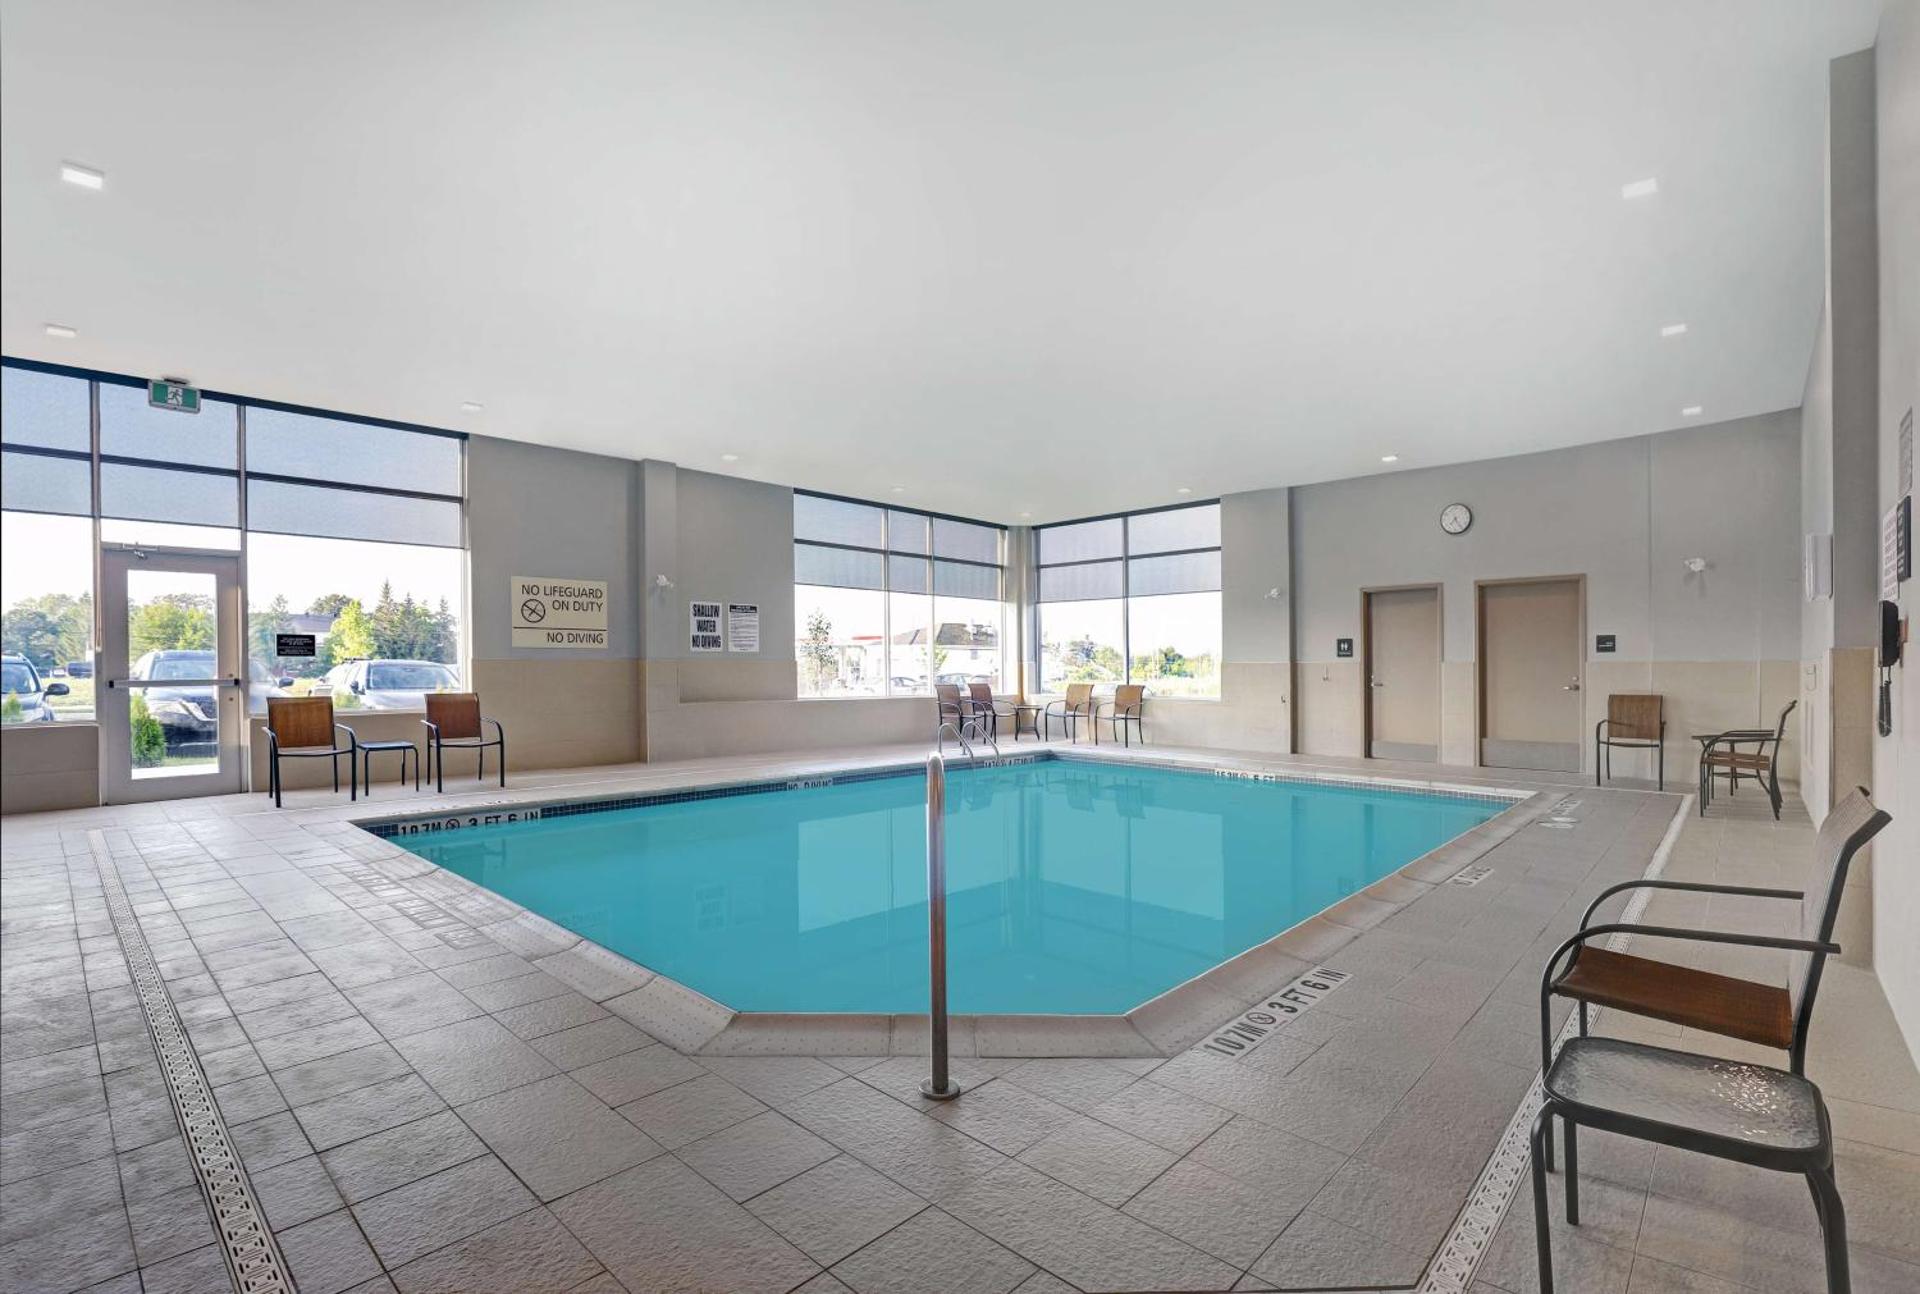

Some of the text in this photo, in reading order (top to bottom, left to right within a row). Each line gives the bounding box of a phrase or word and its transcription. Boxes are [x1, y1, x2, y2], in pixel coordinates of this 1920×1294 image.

[521, 584, 603, 600] NO LIFEGUARD
[552, 599, 604, 612] ON DUTY
[696, 619, 716, 633] WATER
[547, 631, 604, 645] NO DIVING
[1312, 968, 1347, 982] IN
[1301, 980, 1330, 990] 6
[1280, 988, 1317, 1005] FT
[1268, 1002, 1298, 1013] 3
